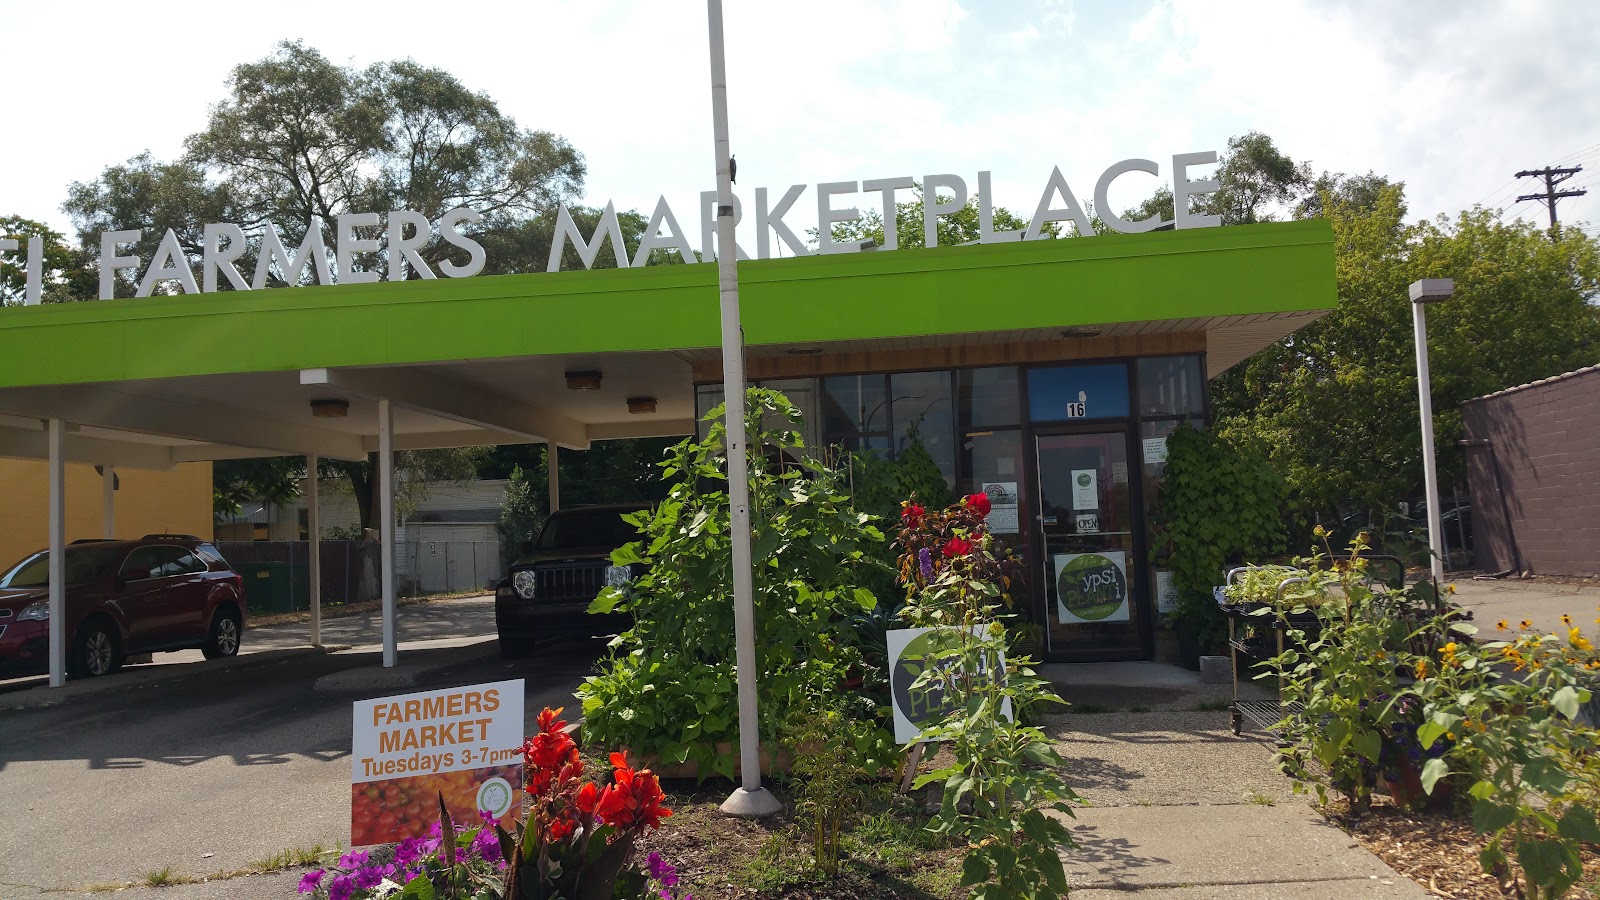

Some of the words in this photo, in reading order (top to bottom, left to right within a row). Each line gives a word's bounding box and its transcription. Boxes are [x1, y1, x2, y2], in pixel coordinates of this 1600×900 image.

[98, 207, 487, 300] FARMERS
[547, 150, 1222, 273] MARKETPLACE
[1069, 403, 1084, 417] 16
[1078, 518, 1097, 529] OPEN
[1082, 566, 1116, 592] ypsi
[373, 689, 500, 727] FARMERS
[379, 718, 492, 753] MARKET
[361, 751, 454, 777] Tuesdays
[461, 746, 513, 765] 3-7pm
